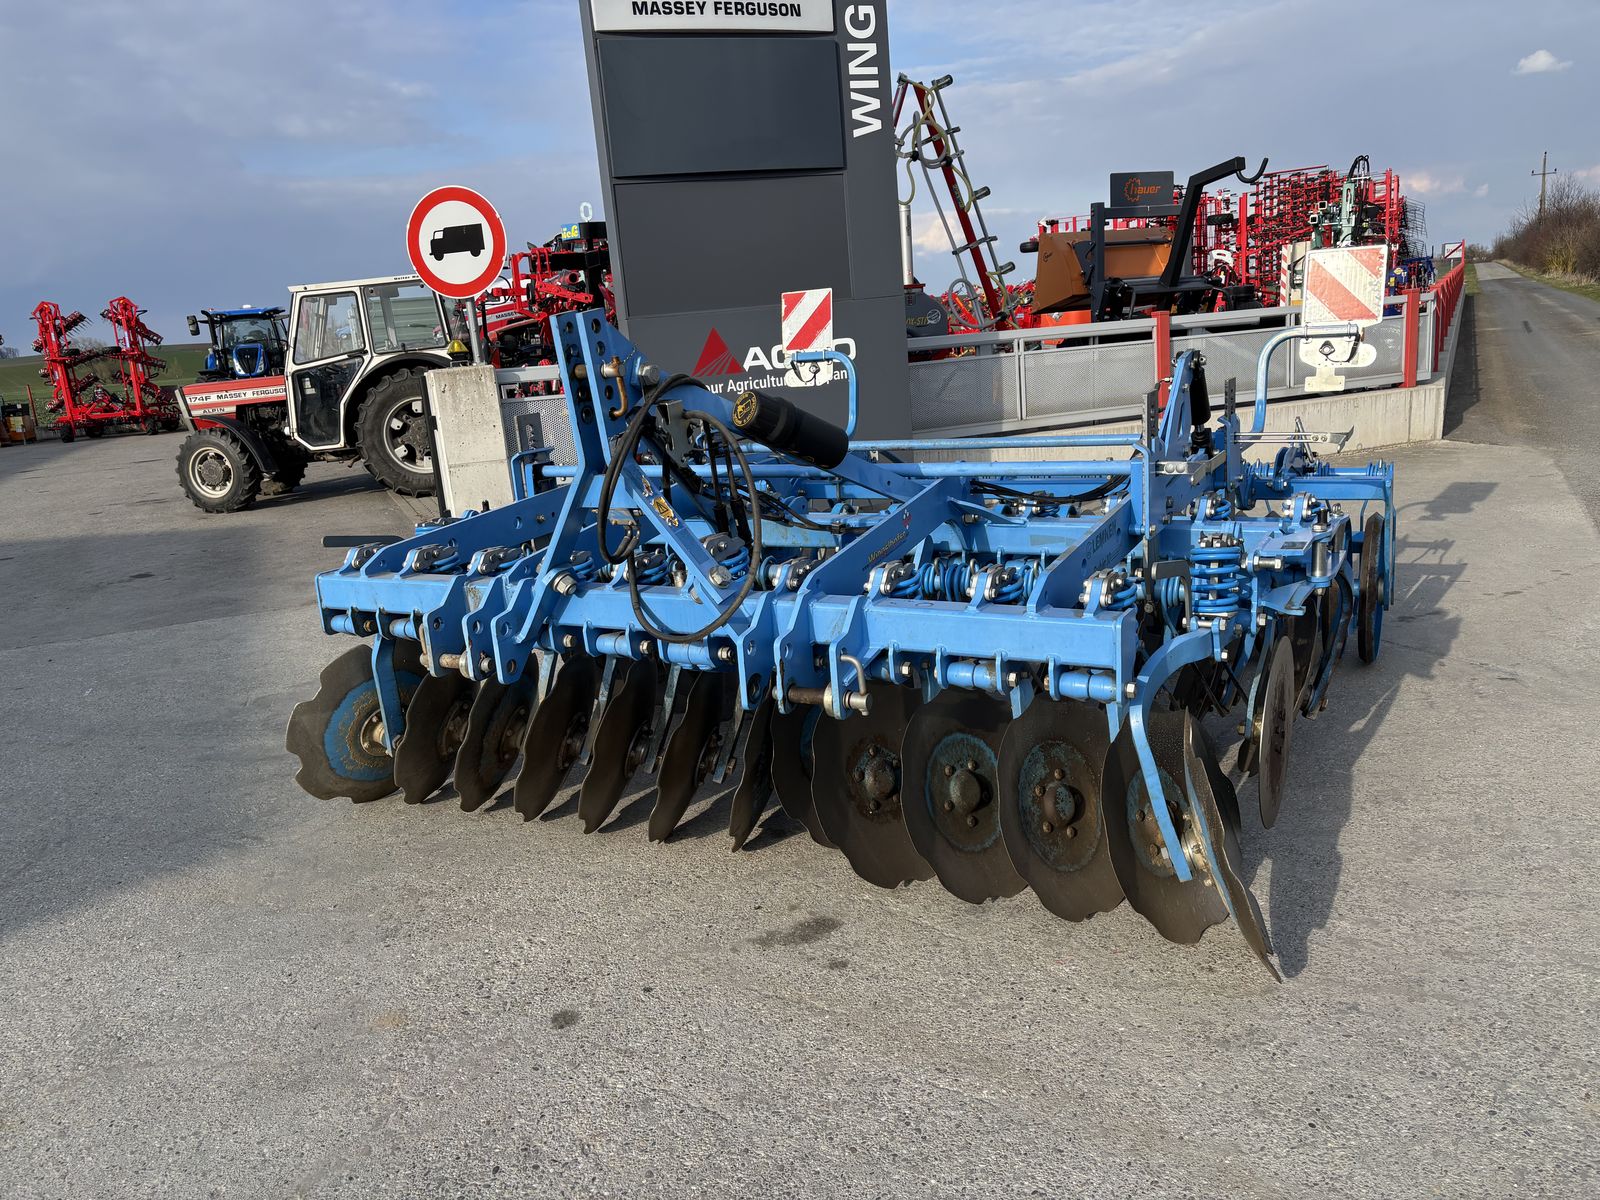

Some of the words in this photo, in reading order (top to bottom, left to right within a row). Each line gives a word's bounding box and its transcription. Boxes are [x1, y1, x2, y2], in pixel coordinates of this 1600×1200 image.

[631, 1, 707, 16] MASSEY
[713, 1, 802, 17] FERGUSON
[844, 4, 883, 138] WING
[703, 380, 724, 395] our
[727, 373, 788, 395] Agricultu
[188, 395, 212, 403] 174F
[216, 391, 247, 400] MASSEY
